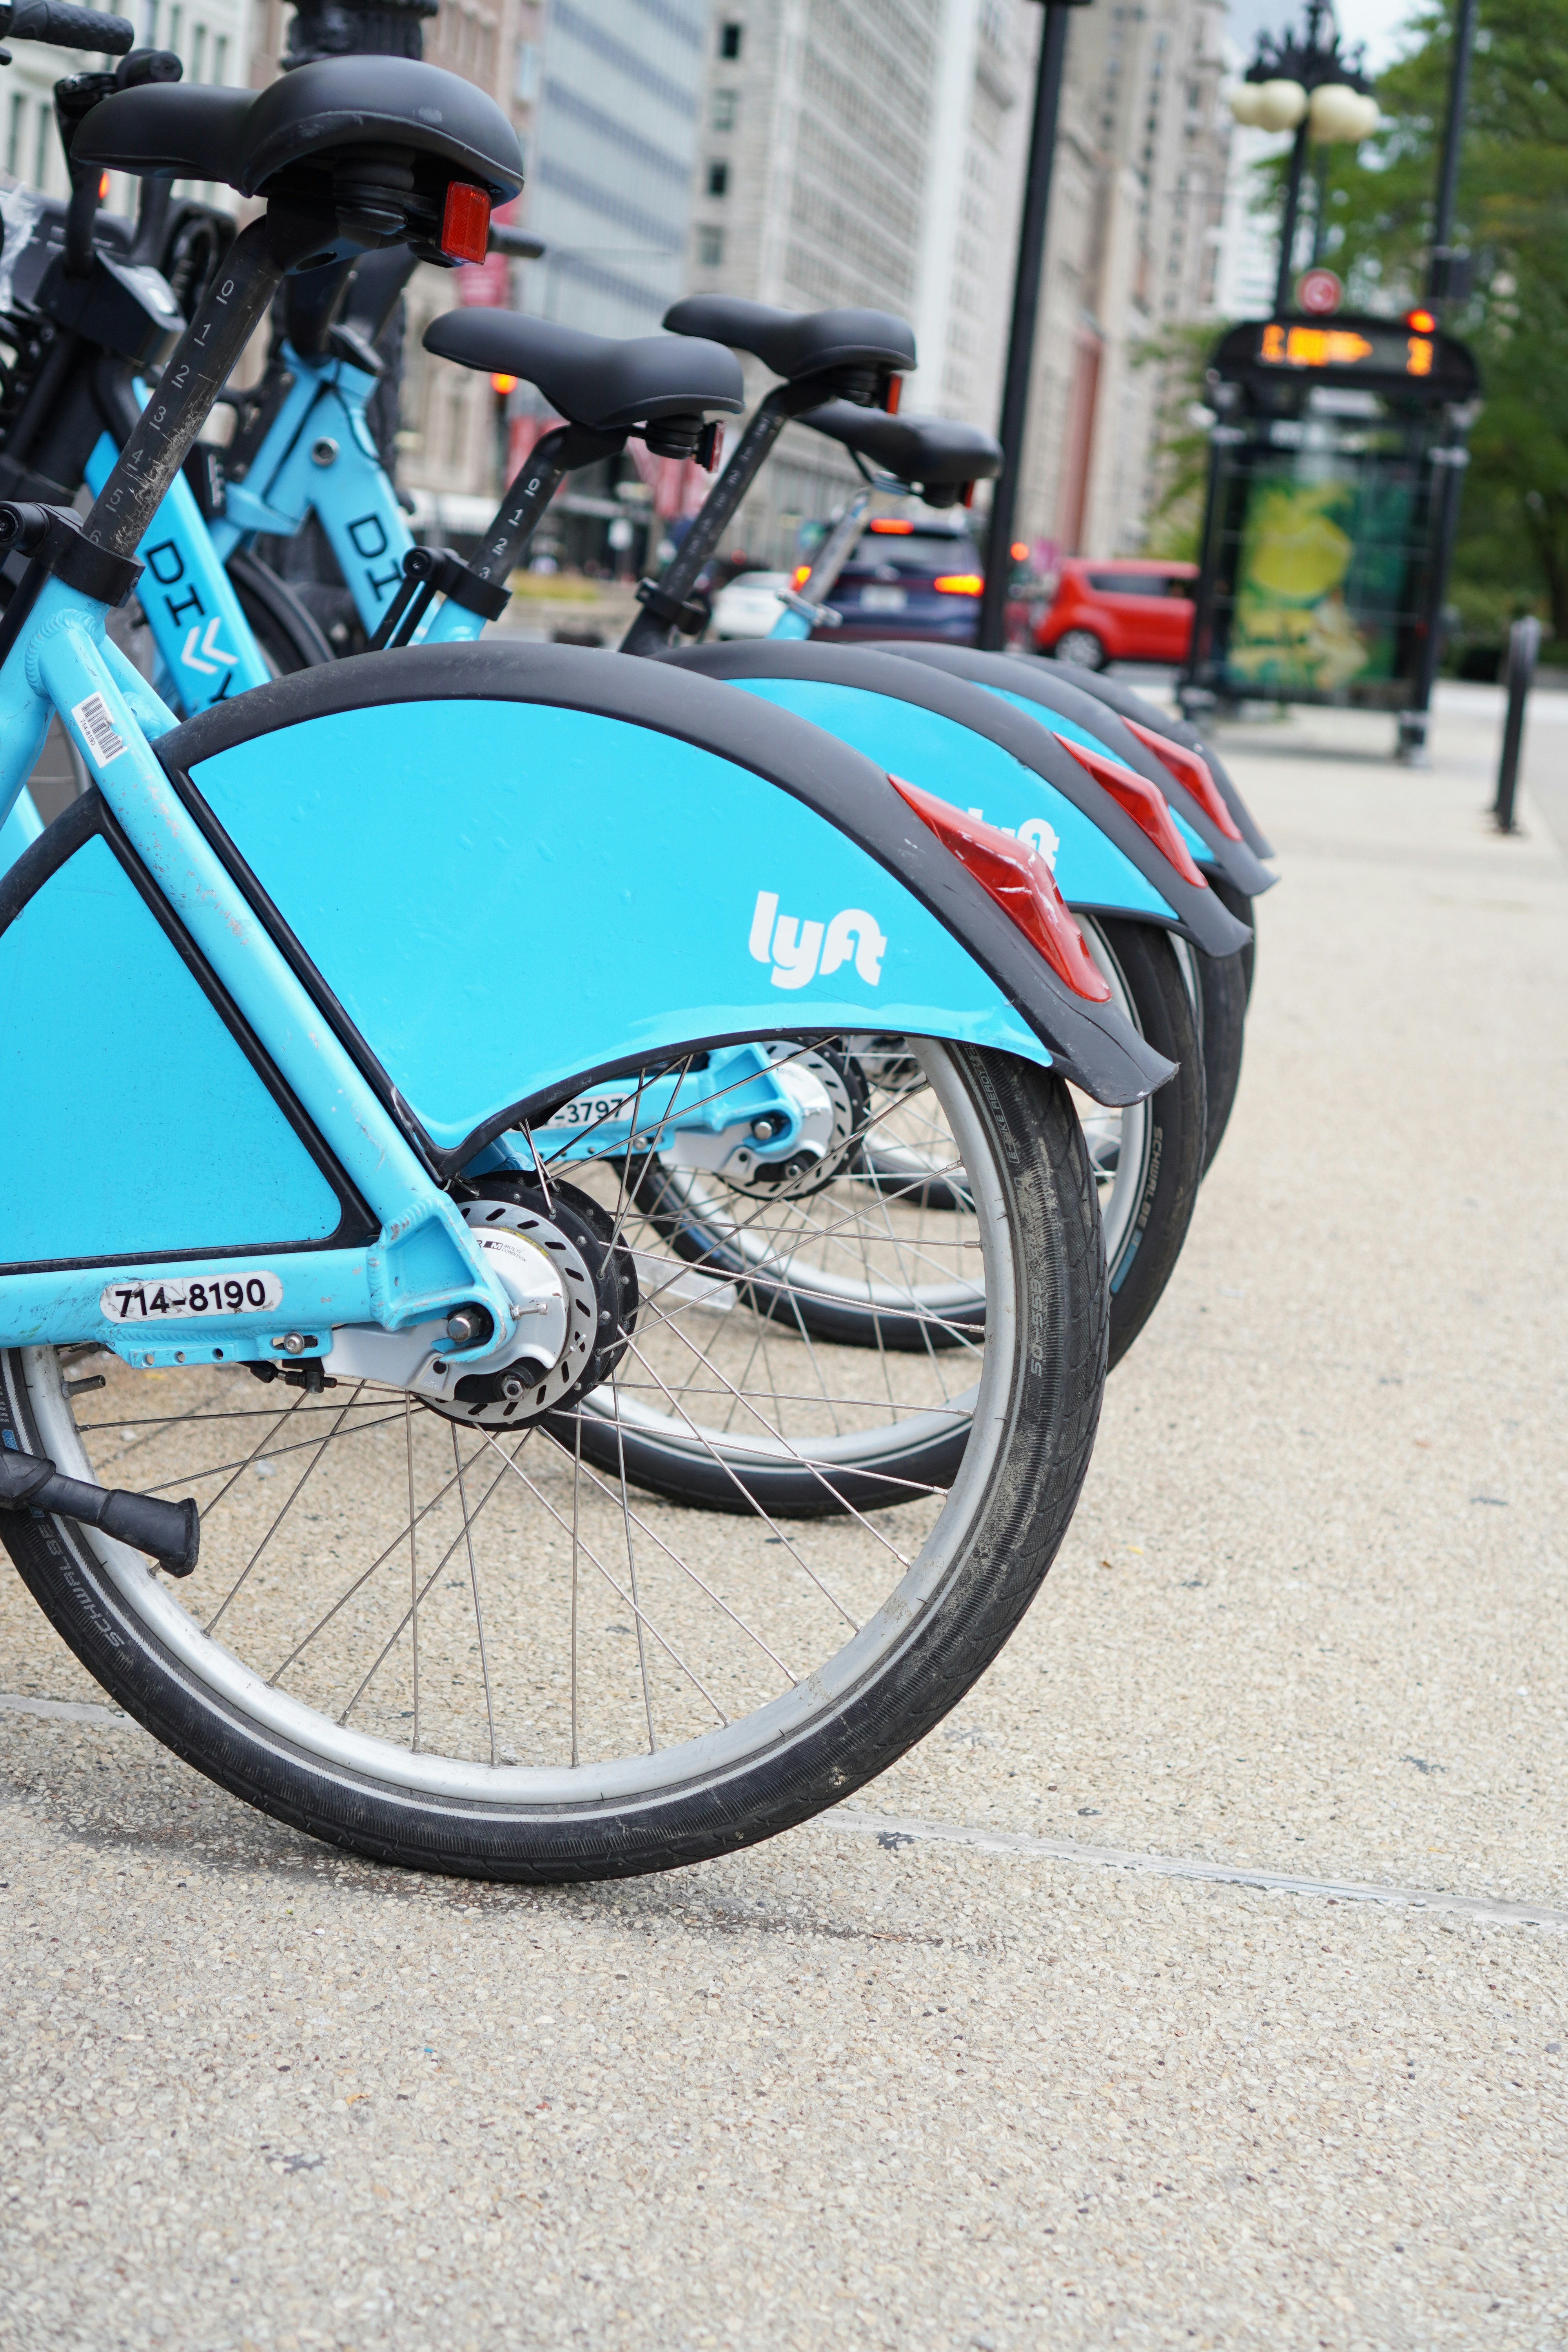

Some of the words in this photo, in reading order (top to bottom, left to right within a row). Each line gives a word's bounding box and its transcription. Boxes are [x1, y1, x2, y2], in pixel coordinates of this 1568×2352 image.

[221, 279, 234, 297] 0
[201, 323, 211, 339] 1
[175, 365, 189, 383] 2
[154, 406, 166, 423] 3
[131, 449, 143, 464] 4
[528, 478, 541, 492] 0
[110, 488, 123, 505] 5
[514, 509, 523, 521] 1
[89, 530, 102, 544] 6
[494, 537, 508, 552] 2
[479, 566, 490, 580] 3
[80, 719, 96, 746] 714-8190
[968, 807, 1060, 872] ft
[748, 890, 887, 990] lyft
[978, 1071, 1000, 1110] READY
[544, 1098, 623, 1124] -3797
[1139, 1125, 1163, 1229] SCHWALBE
[502, 1248, 527, 1262] CONDITION
[504, 1245, 521, 1254] MULTI
[115, 1279, 265, 1318] 714-8190
[1030, 1278, 1044, 1378] 50-559
[422, 1381, 440, 1390] GREASE
[37, 1524, 125, 1647] SCHWALBE
